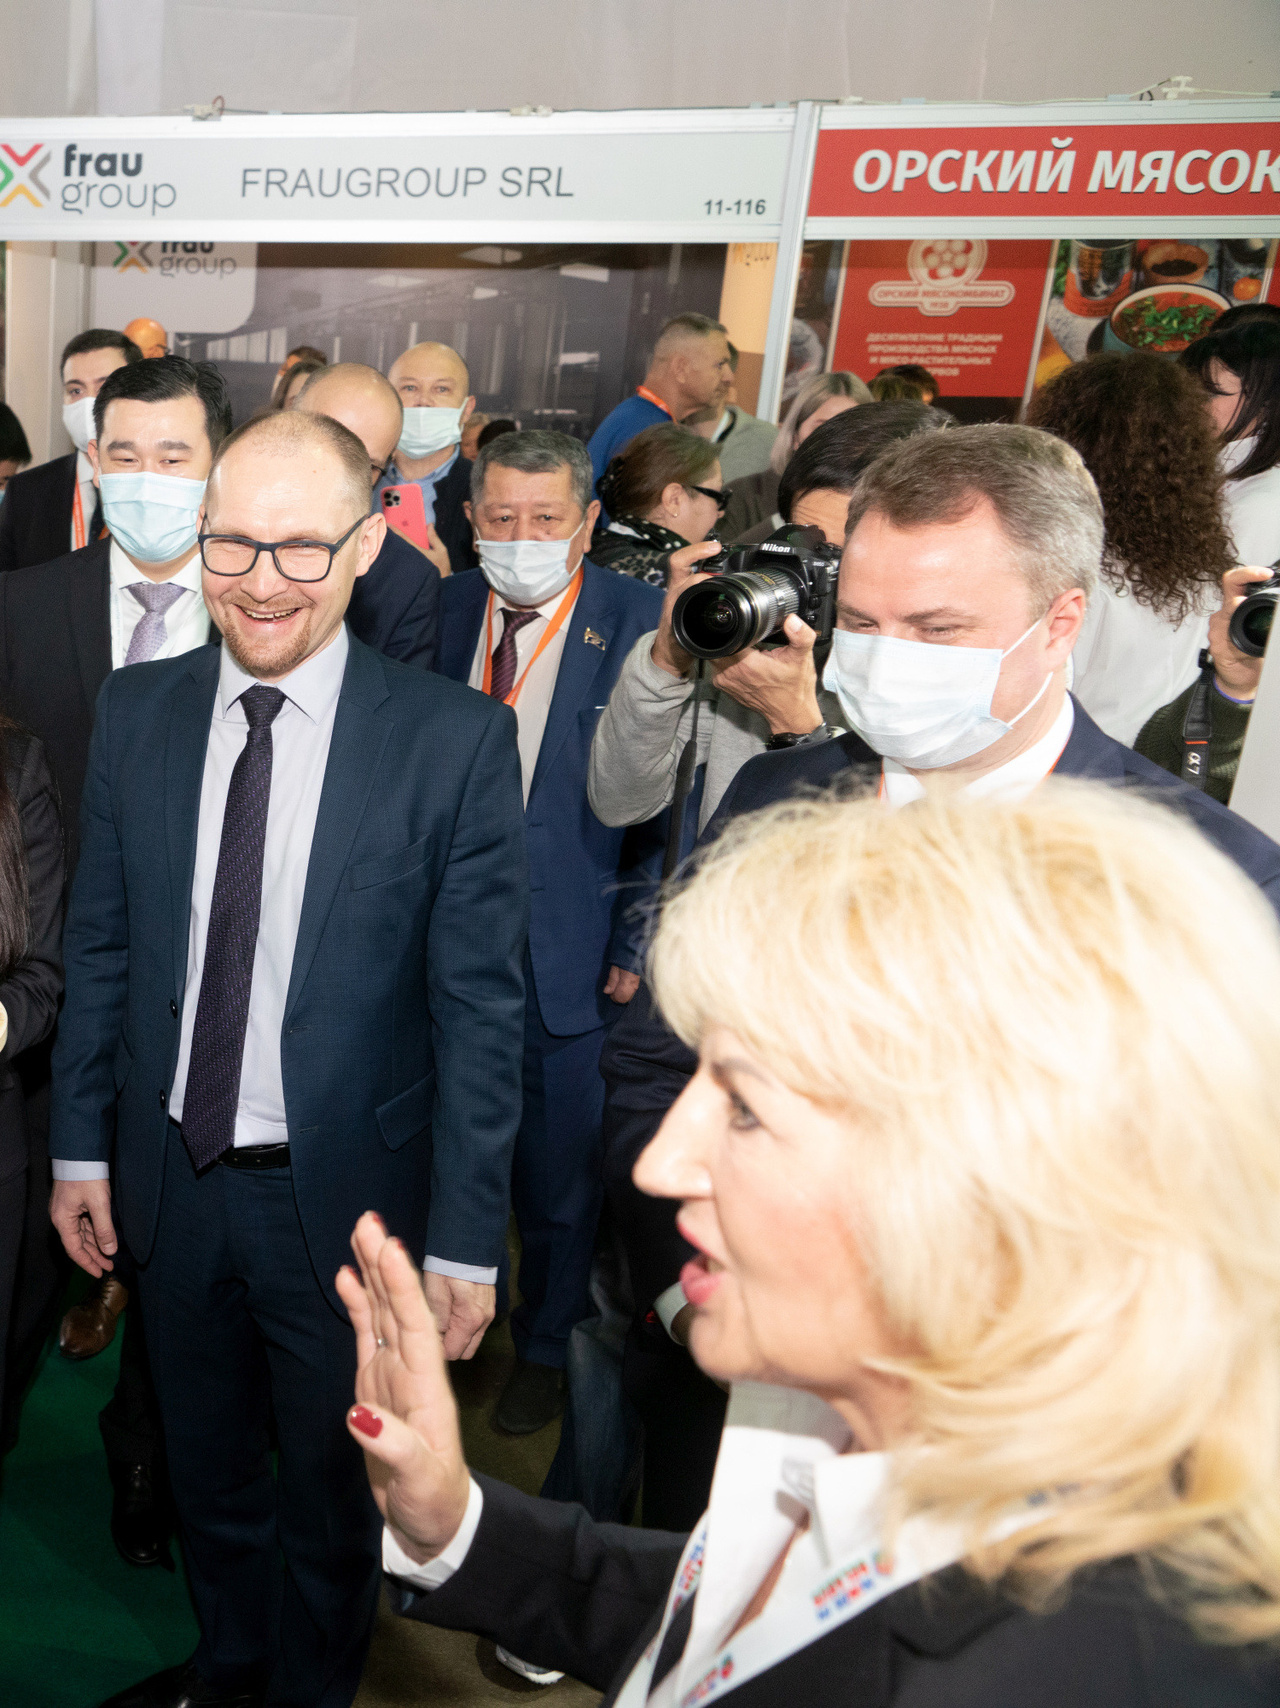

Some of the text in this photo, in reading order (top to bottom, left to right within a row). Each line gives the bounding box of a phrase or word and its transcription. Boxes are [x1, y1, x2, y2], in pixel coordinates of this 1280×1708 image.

[63, 143, 143, 177] frau
[852, 136, 1077, 193] ОРСКИЙ
[241, 166, 574, 198] FRAUGROUP SRL
[61, 181, 177, 216] group
[704, 199, 767, 215] 11-116
[159, 256, 237, 279] group
[761, 542, 791, 553] Nikon
